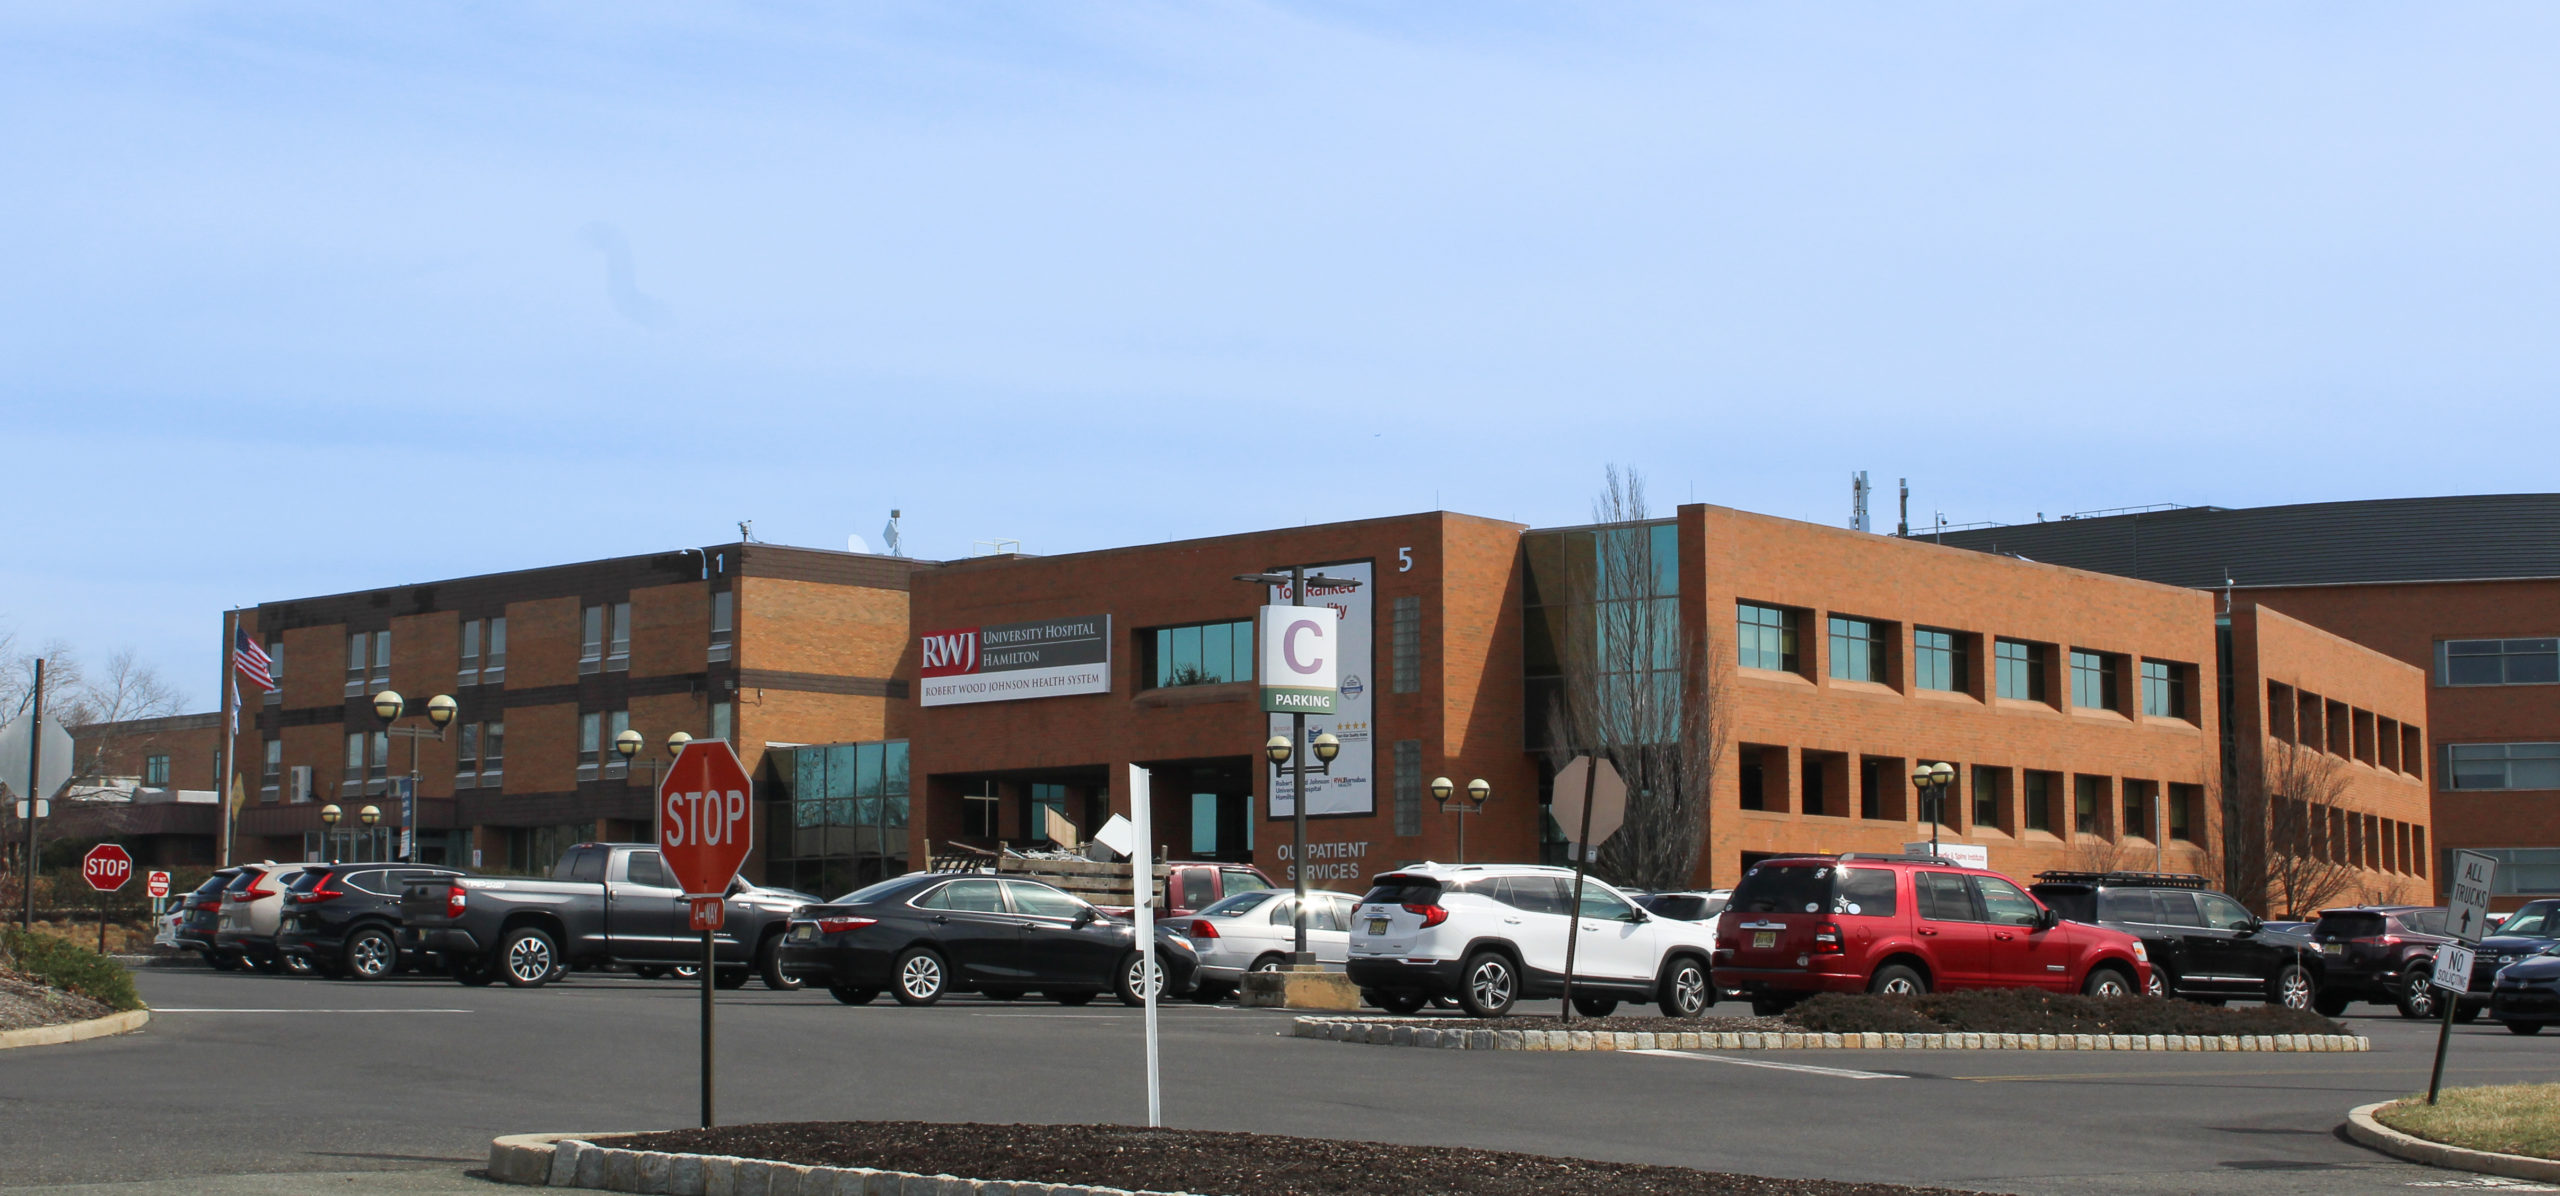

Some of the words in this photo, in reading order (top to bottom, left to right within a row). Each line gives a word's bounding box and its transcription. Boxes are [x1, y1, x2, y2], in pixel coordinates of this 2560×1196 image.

[716, 553, 724, 573] 1
[1399, 547, 1412, 572] 5
[983, 627, 1043, 645] UNIVERSITY
[1045, 622, 1096, 638] HOSPITAL
[921, 632, 978, 672] RWJ
[1283, 619, 1323, 675] C
[983, 650, 1040, 667] HAMILTON
[925, 684, 957, 697] ROBERT
[958, 682, 987, 694] WOOD
[988, 679, 1030, 693] JOHNSON
[1032, 676, 1066, 688] HEALTH
[1067, 673, 1100, 685] SYSTEM
[1275, 694, 1330, 708] PARKING
[666, 789, 745, 847] STOP
[1278, 841, 1368, 860] OUPATIENT
[87, 858, 129, 877] STOP
[1287, 862, 1359, 880] SRVICES
[2465, 862, 2483, 883] ALL
[2455, 883, 2487, 909] TRUCKS
[695, 902, 719, 925] 4-WAY
[2448, 950, 2464, 972] NO
